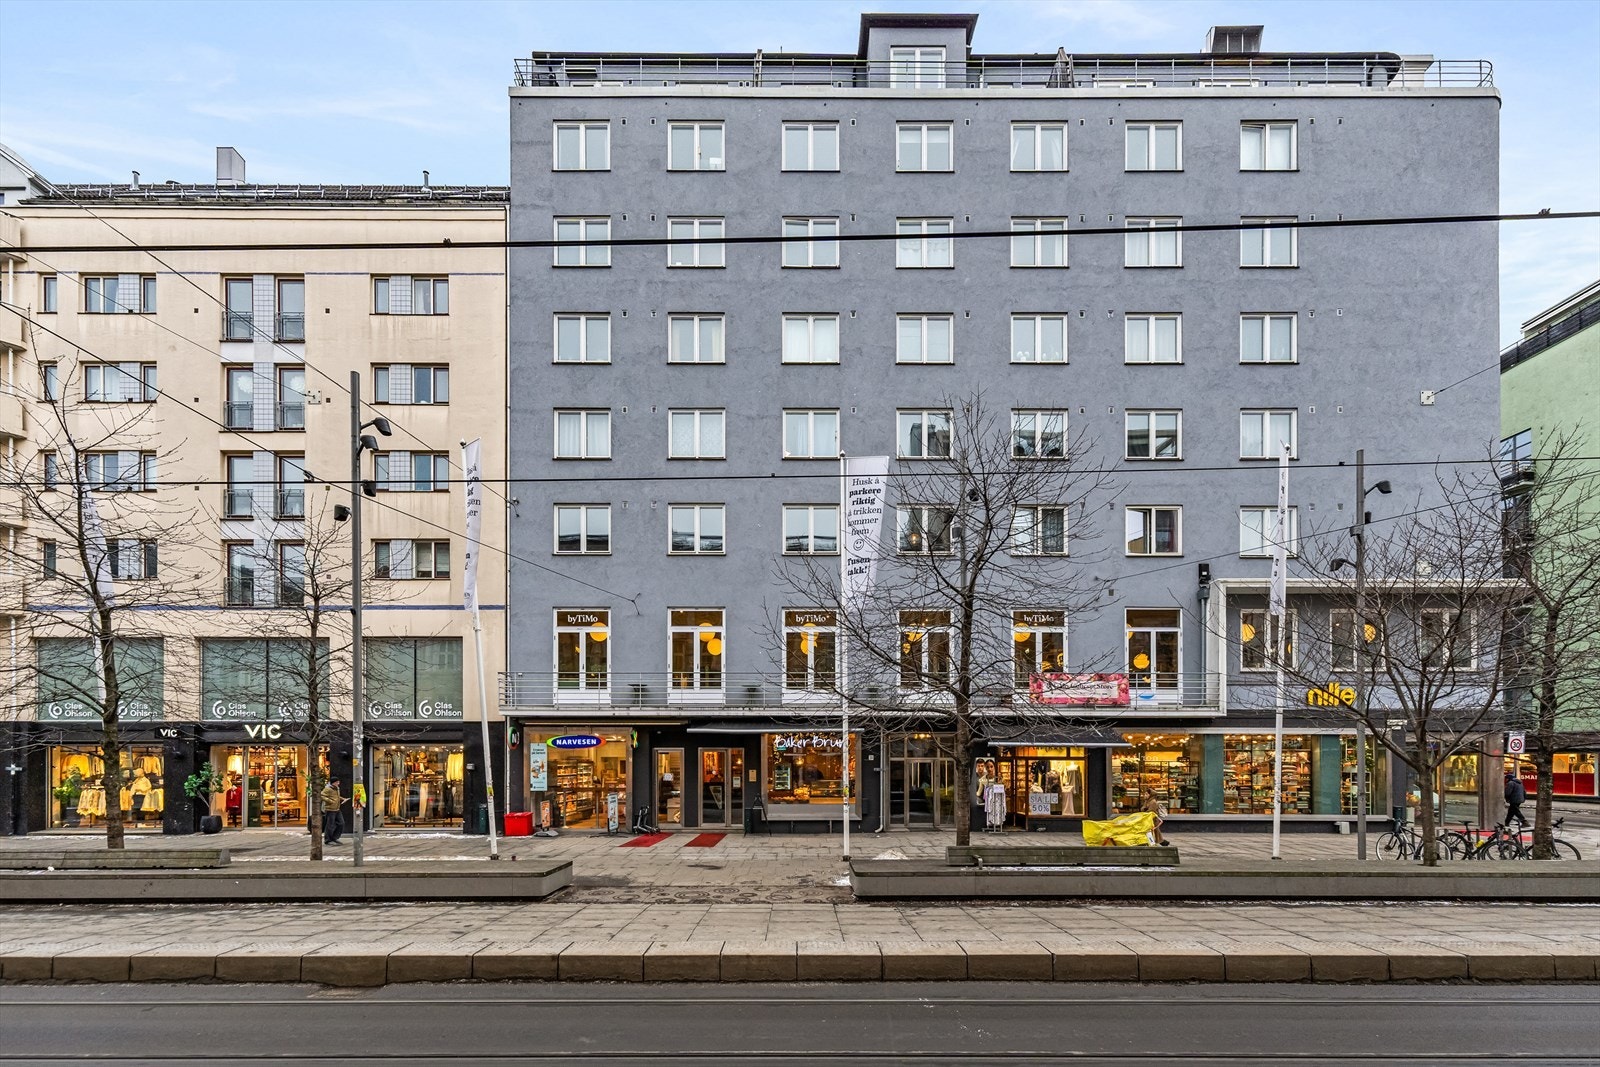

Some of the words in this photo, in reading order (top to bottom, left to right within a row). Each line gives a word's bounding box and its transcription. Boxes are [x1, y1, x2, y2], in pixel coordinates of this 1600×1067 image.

[852, 478, 873, 486] Husk
[849, 488, 882, 498] parkere
[852, 497, 876, 505] riktig
[854, 507, 882, 515] trikken
[567, 614, 599, 624] byTiMo
[795, 614, 827, 624] byTiMo
[1307, 682, 1357, 707] nille
[160, 729, 178, 738] VIC
[244, 724, 282, 739] VIC
[556, 738, 597, 746] NARVESEN
[775, 734, 810, 749] Baker
[1512, 741, 1521, 749] 30
[1032, 804, 1050, 813] 50%
